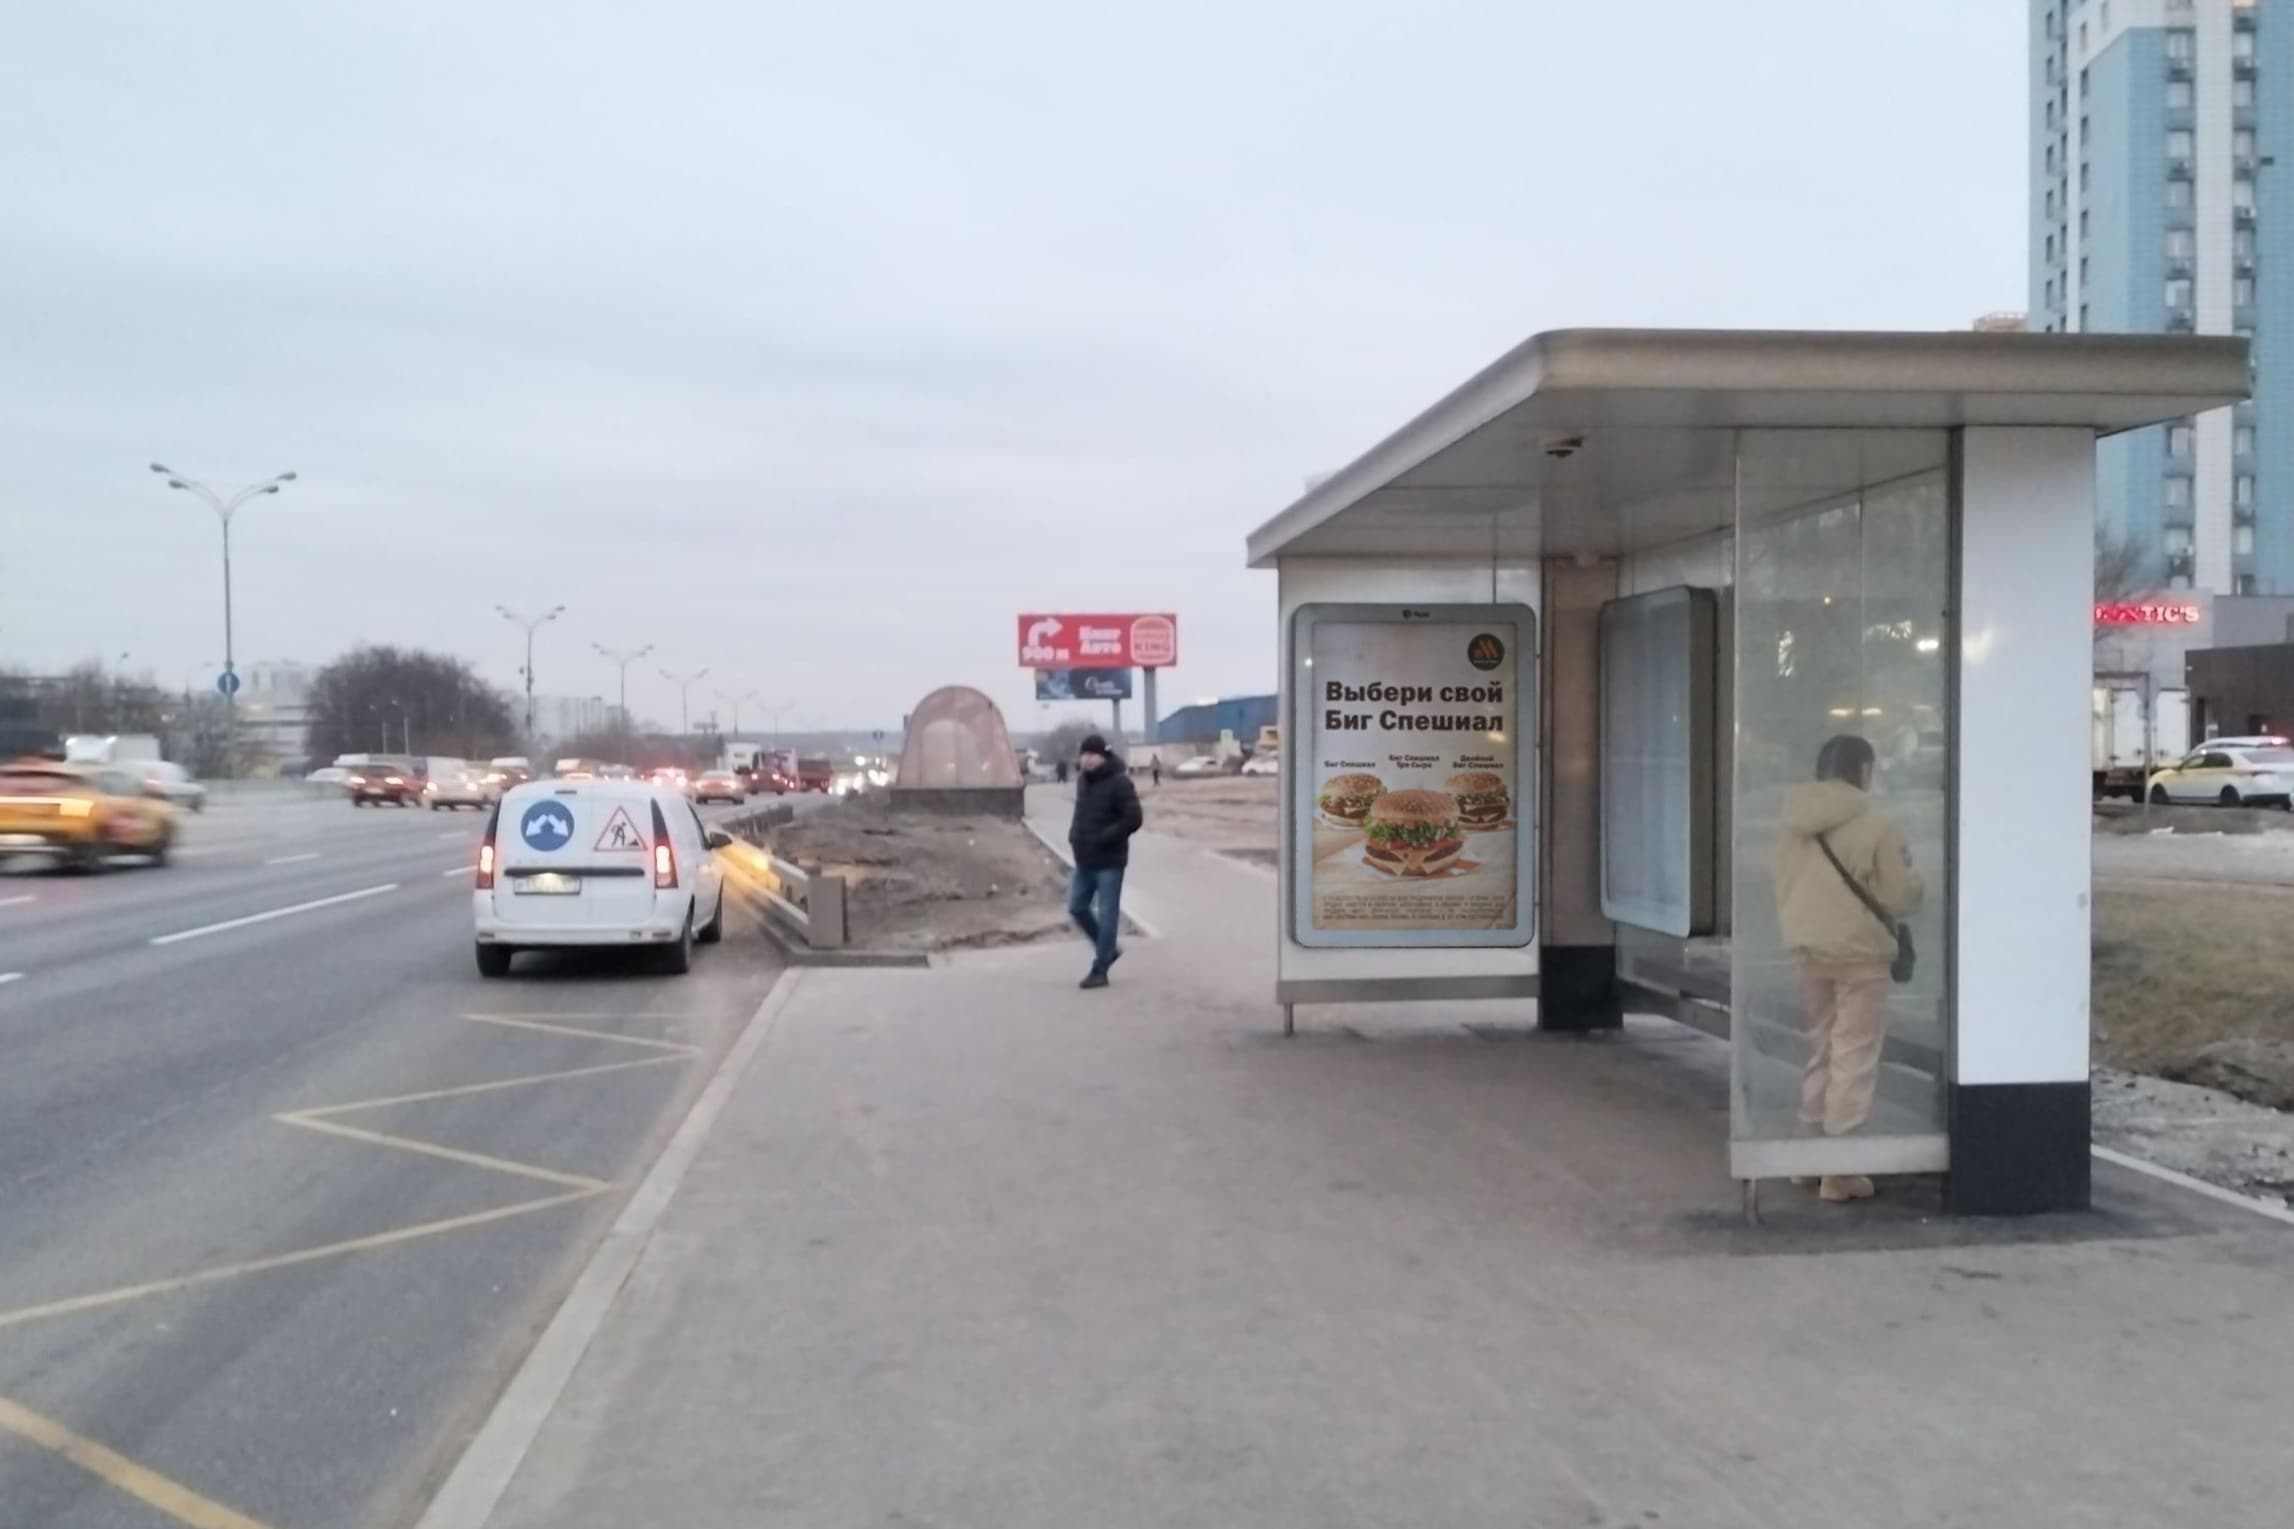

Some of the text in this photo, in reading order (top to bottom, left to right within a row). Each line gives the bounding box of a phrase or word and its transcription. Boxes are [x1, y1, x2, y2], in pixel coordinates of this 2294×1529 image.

[1326, 681, 1503, 706] Выбери свой
[1325, 710, 1503, 731] Биг Спешиал
